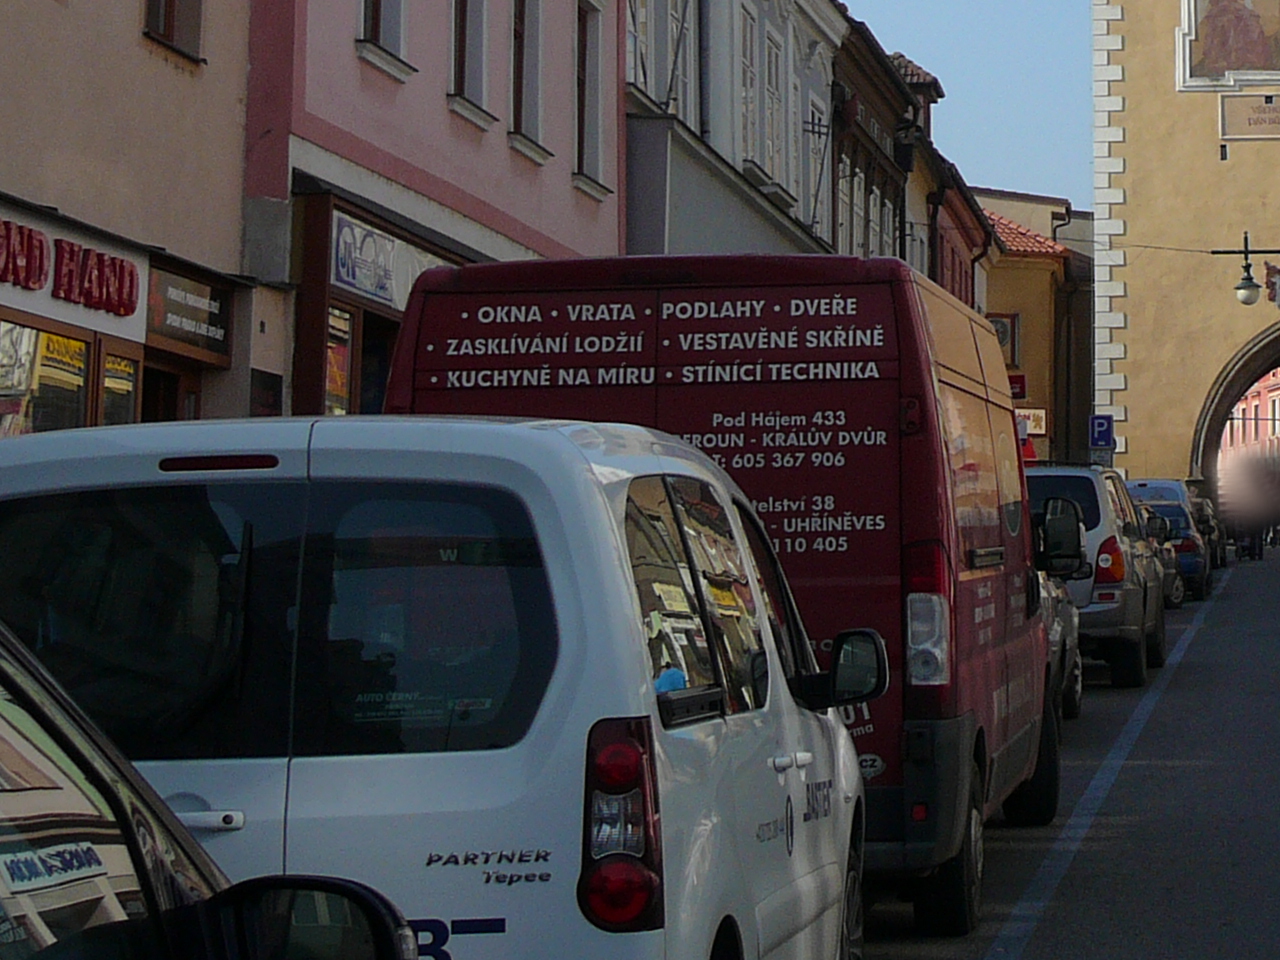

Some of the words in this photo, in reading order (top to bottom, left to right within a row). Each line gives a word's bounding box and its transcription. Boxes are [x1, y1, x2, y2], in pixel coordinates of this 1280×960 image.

[0, 220, 49, 290] ND
[51, 238, 140, 317] HAND
[477, 305, 542, 324] OKNA
[567, 303, 636, 322] VRATA
[662, 300, 766, 320] PODLAHY
[790, 293, 857, 317] DVEŘE
[446, 332, 569, 356] ZASKLÍVÁNÍ
[574, 331, 645, 354] LODŽIÍ
[678, 326, 798, 351] VESTAVĚNÉ
[805, 324, 884, 348] SKŘÍNĚ
[446, 364, 551, 388] KUCHYNĚ
[557, 368, 591, 386] NA
[597, 362, 656, 385] MÍRU
[681, 359, 763, 383] STÍNÍCÍ
[768, 361, 880, 381] TECHNIKA
[713, 412, 745, 427] Pod
[751, 411, 806, 430] Hájem
[812, 411, 846, 426] 433
[1094, 419, 1108, 438] P
[762, 427, 832, 447] KRÁLŮV
[838, 426, 887, 446] DVŮR
[732, 453, 765, 468] 605
[772, 453, 805, 468] 367
[811, 452, 845, 467] 906
[812, 495, 835, 511] 38
[783, 512, 885, 533] UHŘÍNĚVES
[813, 537, 848, 552] 405
[355, 693, 384, 703] AUTO
[839, 701, 871, 725] 01
[849, 724, 874, 737] rma
[859, 758, 877, 769] CZ
[425, 849, 552, 867] PARTNER
[482, 871, 552, 886] Tepee
